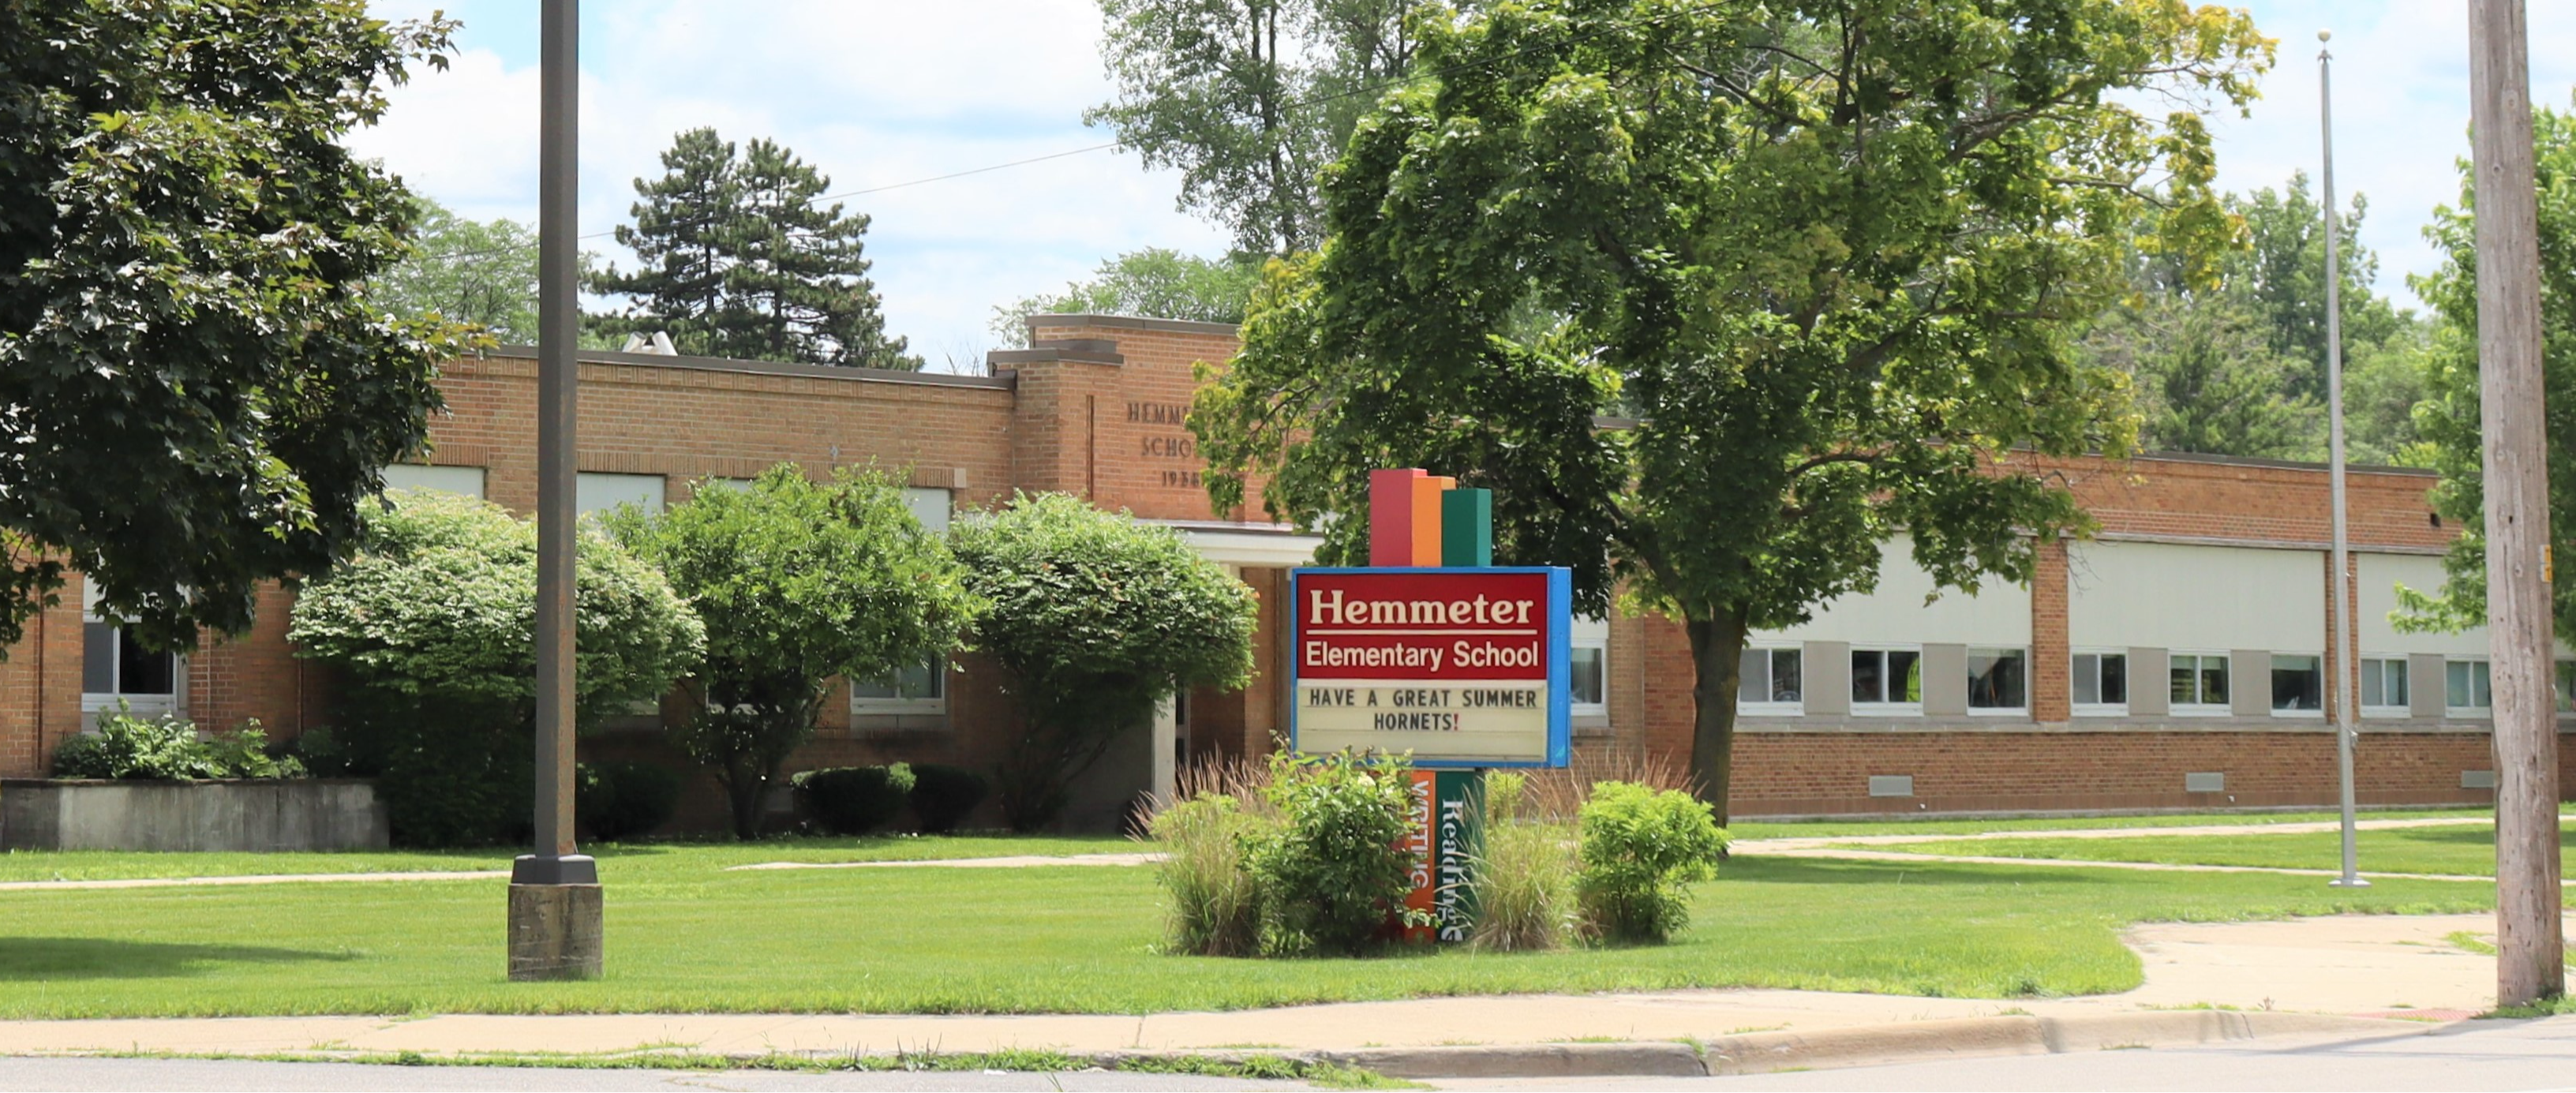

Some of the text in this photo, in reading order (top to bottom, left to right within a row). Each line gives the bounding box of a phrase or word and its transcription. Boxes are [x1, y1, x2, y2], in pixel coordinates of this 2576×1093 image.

[1142, 437, 1193, 459] SCHO
[1309, 590, 1534, 625] Hemmeter
[1305, 640, 1538, 672] Elementary School
[1310, 689, 1537, 708] HAVE A GREAT SUMMER
[1374, 713, 1459, 731] HORNETS!
[1436, 799, 1464, 923] Reading
